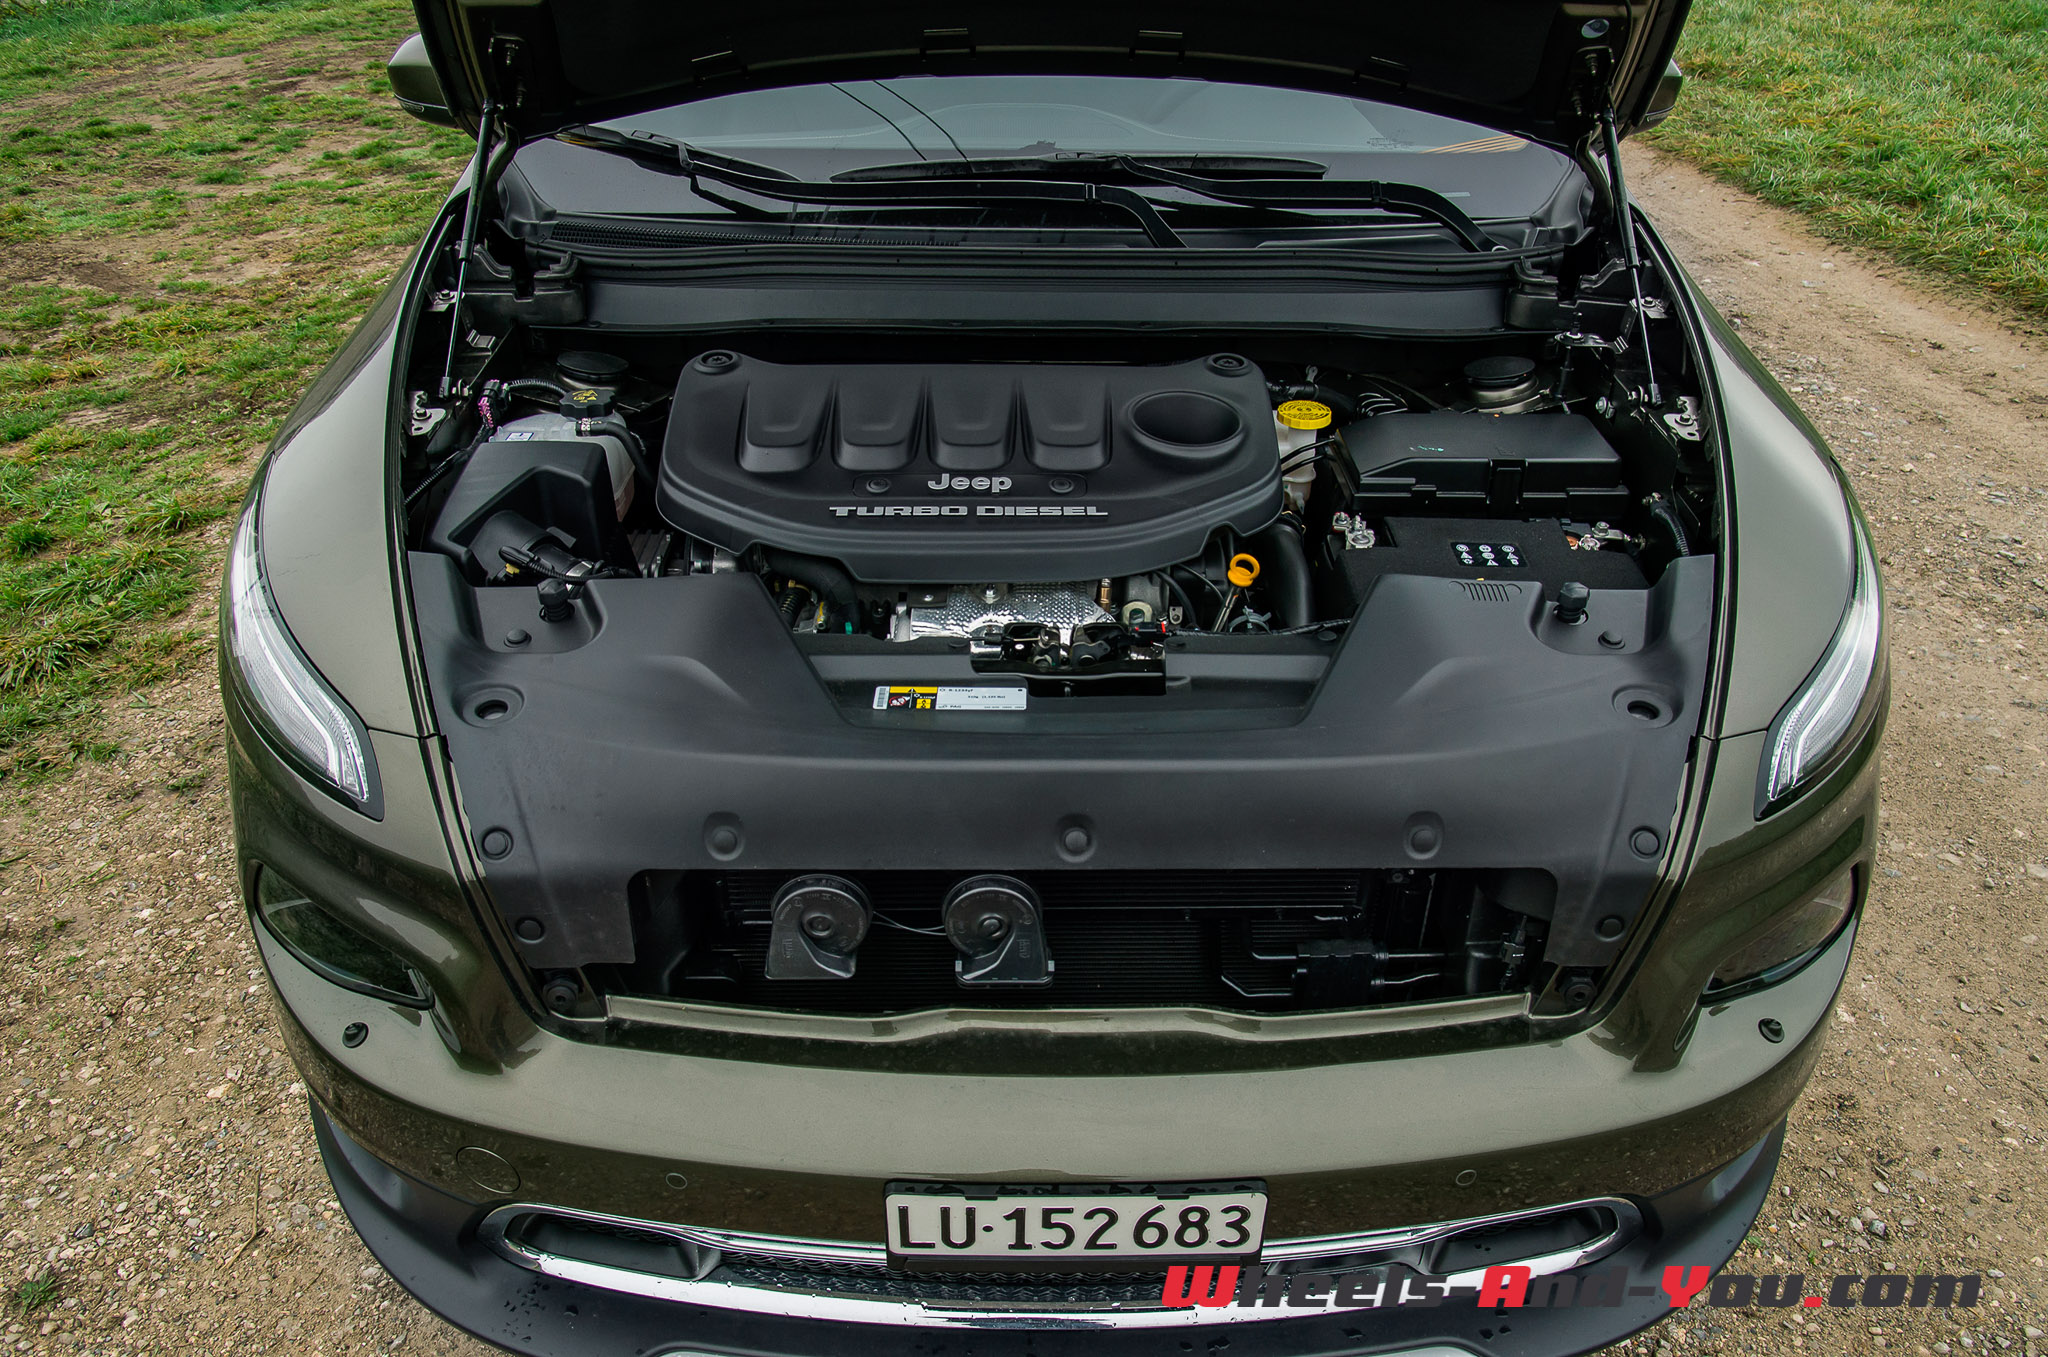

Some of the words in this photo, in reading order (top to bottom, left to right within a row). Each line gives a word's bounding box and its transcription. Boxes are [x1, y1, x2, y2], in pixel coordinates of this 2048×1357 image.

[927, 473, 1012, 493] Jeep
[829, 506, 968, 517] TURBO
[976, 506, 1108, 517] DIESEL
